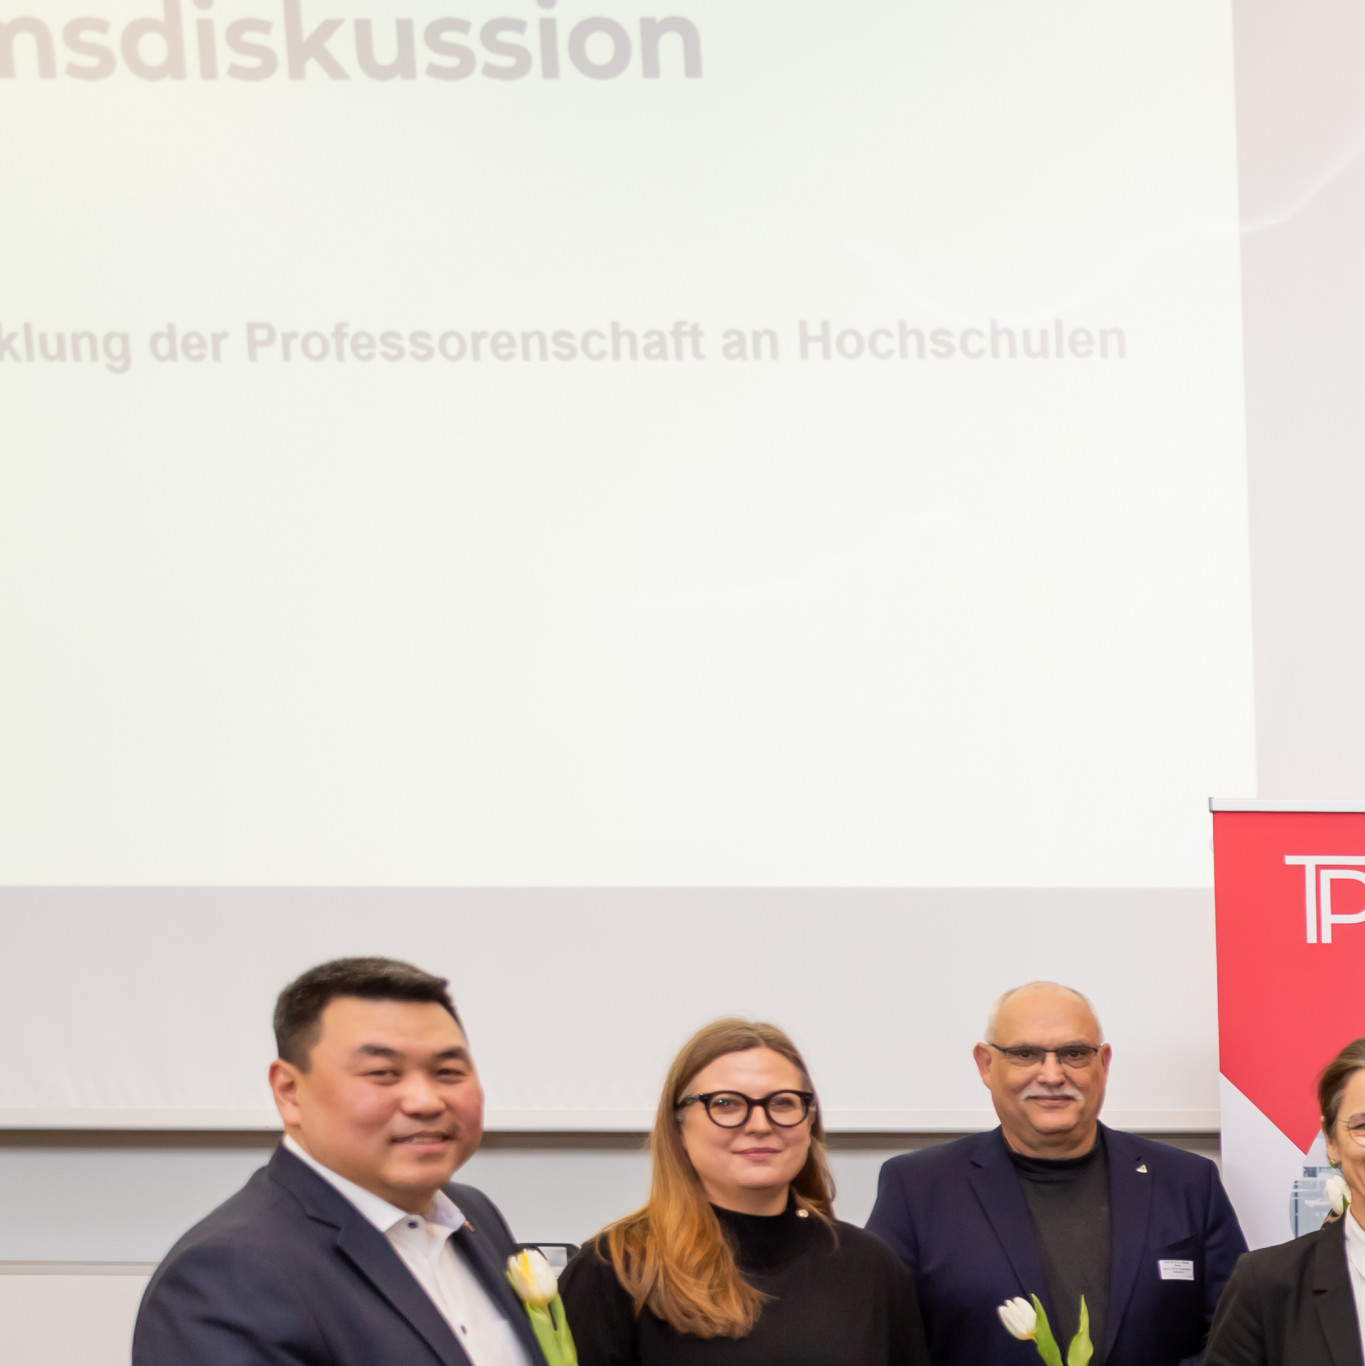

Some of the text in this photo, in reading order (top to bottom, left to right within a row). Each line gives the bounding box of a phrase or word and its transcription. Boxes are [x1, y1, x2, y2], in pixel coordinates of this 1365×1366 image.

[0, 318, 1129, 374] klung der Professorenschaft an Hochschulen
